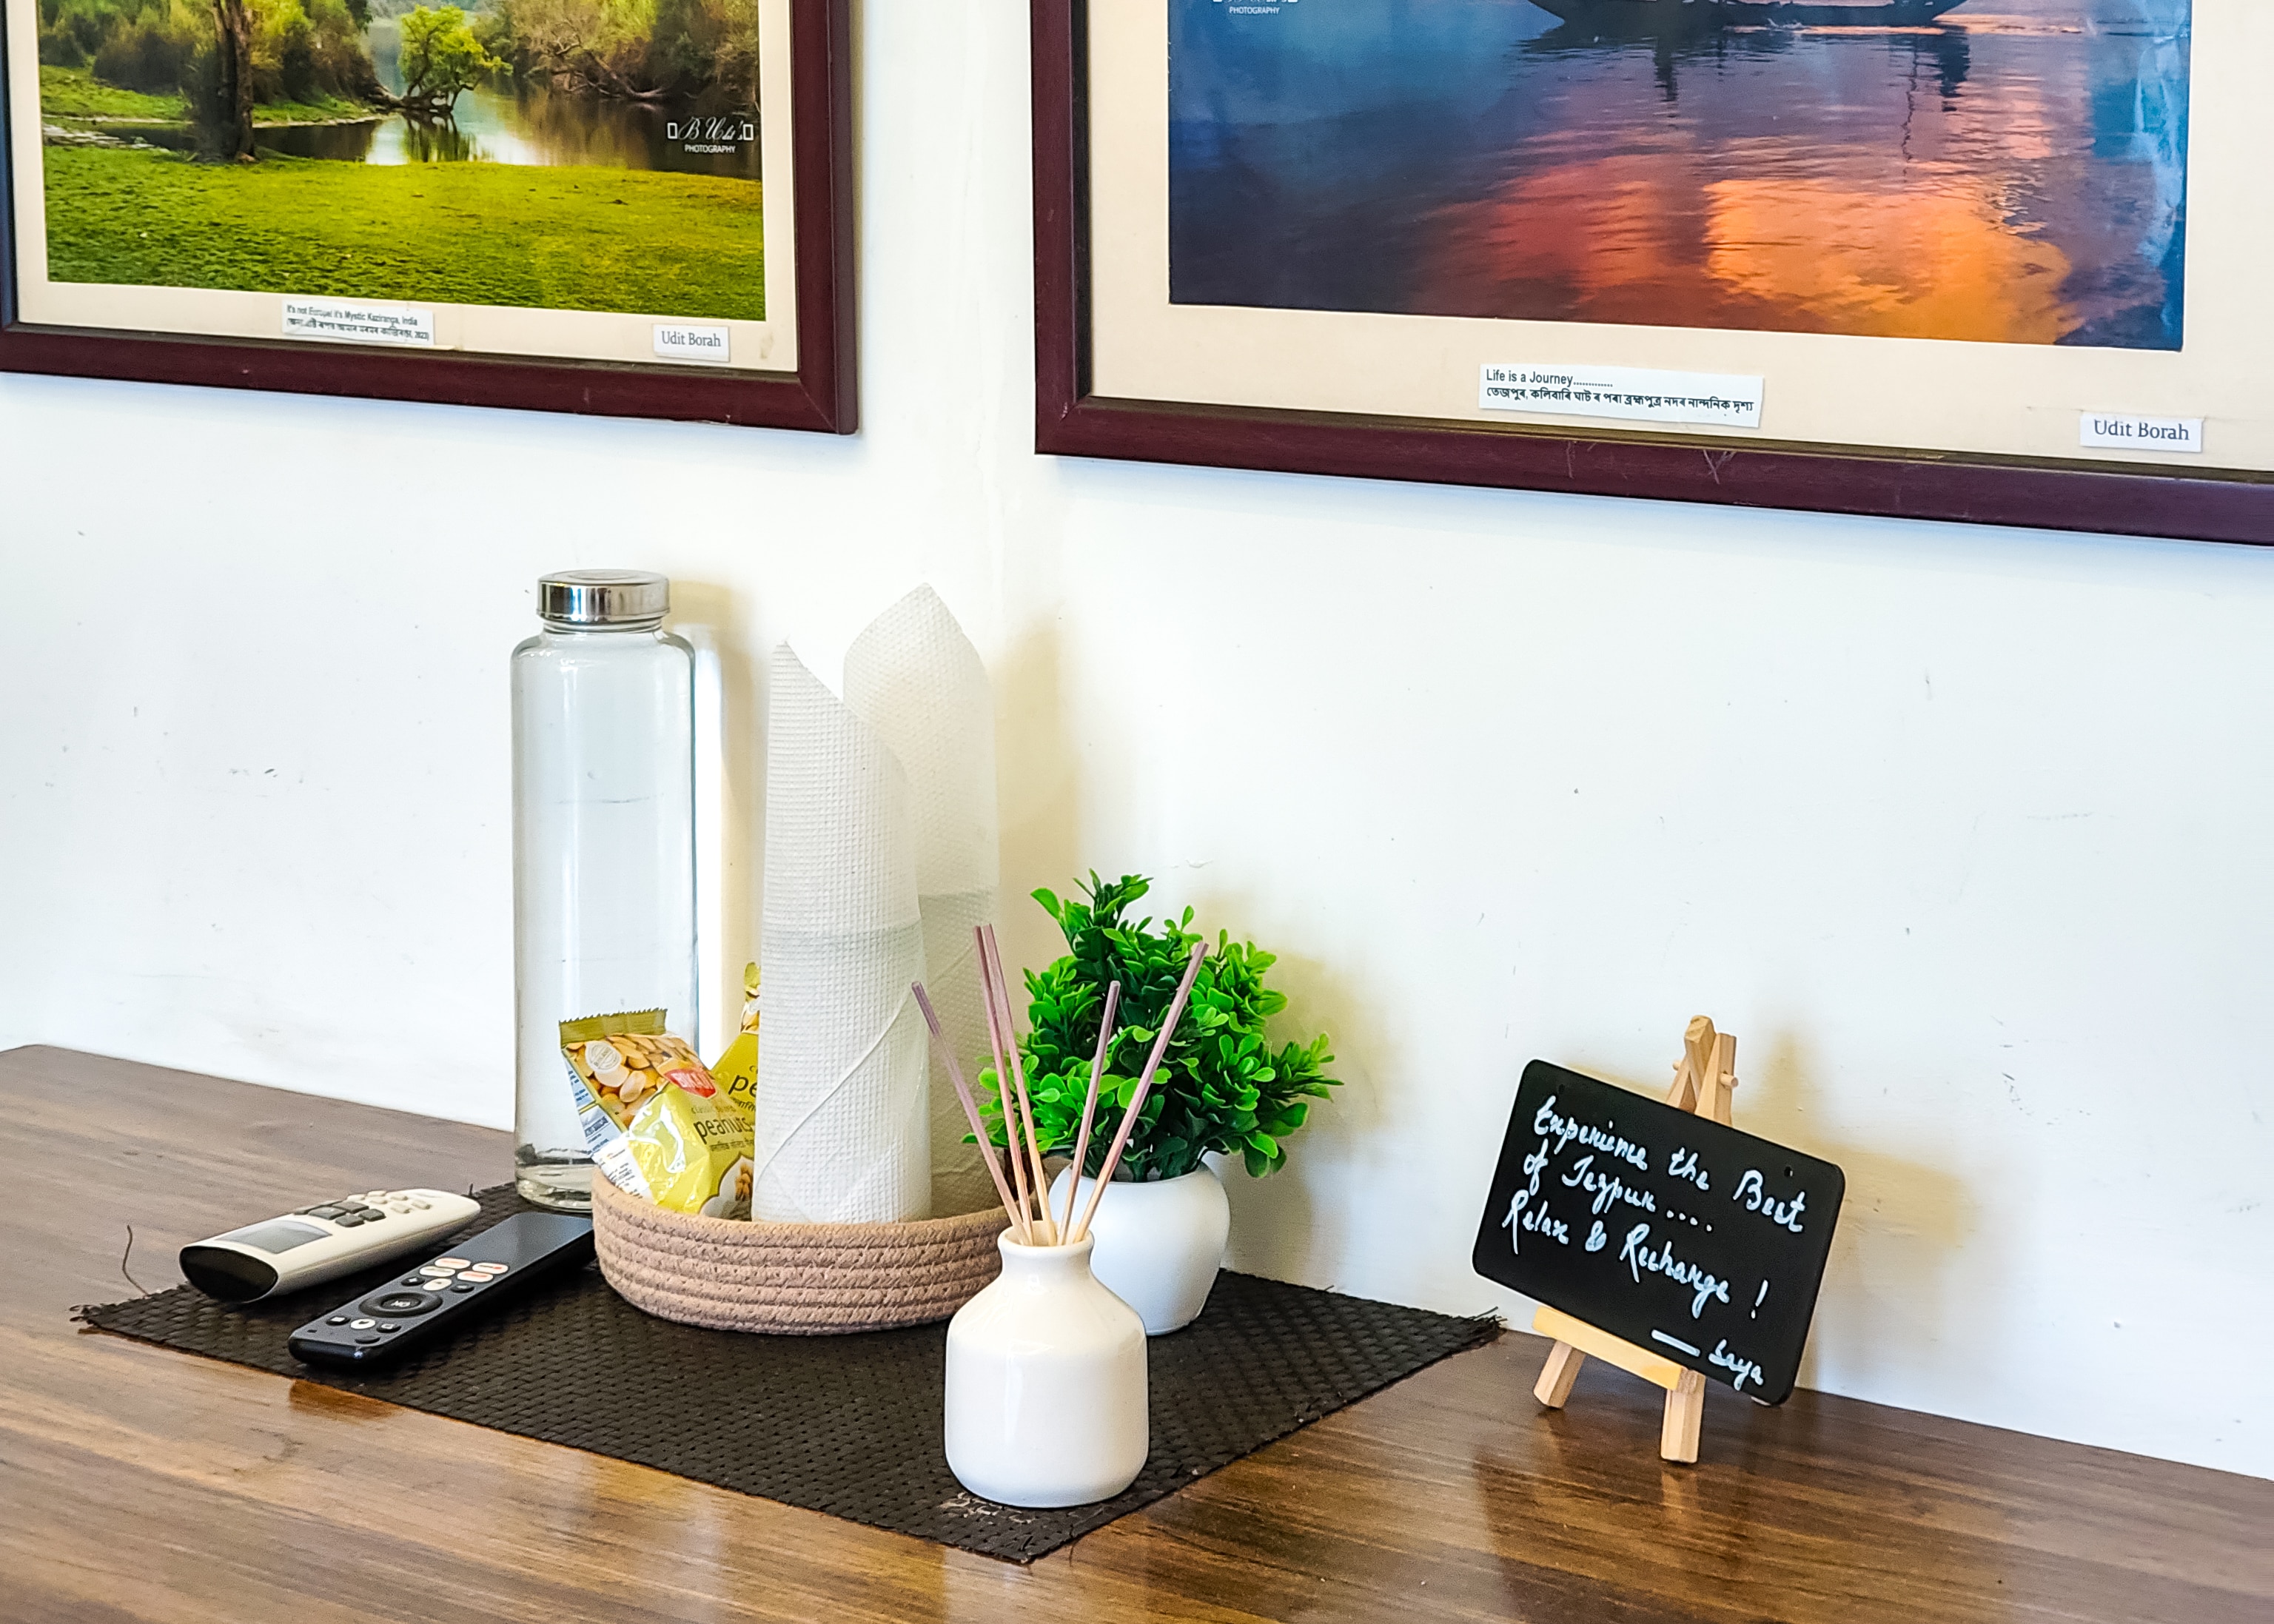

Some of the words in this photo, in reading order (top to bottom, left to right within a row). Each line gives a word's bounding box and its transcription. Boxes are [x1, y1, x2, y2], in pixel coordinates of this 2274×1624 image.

[1229, 6, 1280, 15] PHOTOGRAPHY
[685, 144, 736, 153] PHOTOGRAPHY
[402, 315, 417, 326] India
[661, 330, 685, 345] Udit
[688, 332, 721, 347] Borah
[1486, 369, 1506, 381] Life
[1509, 370, 1517, 382] is
[1520, 374, 1526, 383] a
[1732, 400, 1754, 414] দৃশ্য
[2094, 419, 2133, 437] Udit
[2138, 422, 2190, 440] Borah
[693, 1116, 754, 1145] peanuts
[1523, 1138, 1548, 1195] of
[1669, 1147, 1709, 1190] the
[1734, 1170, 1805, 1232] Best
[1503, 1190, 1569, 1255] Relax
[1585, 1220, 1606, 1252] &
[1620, 1223, 1730, 1319] Recharge
